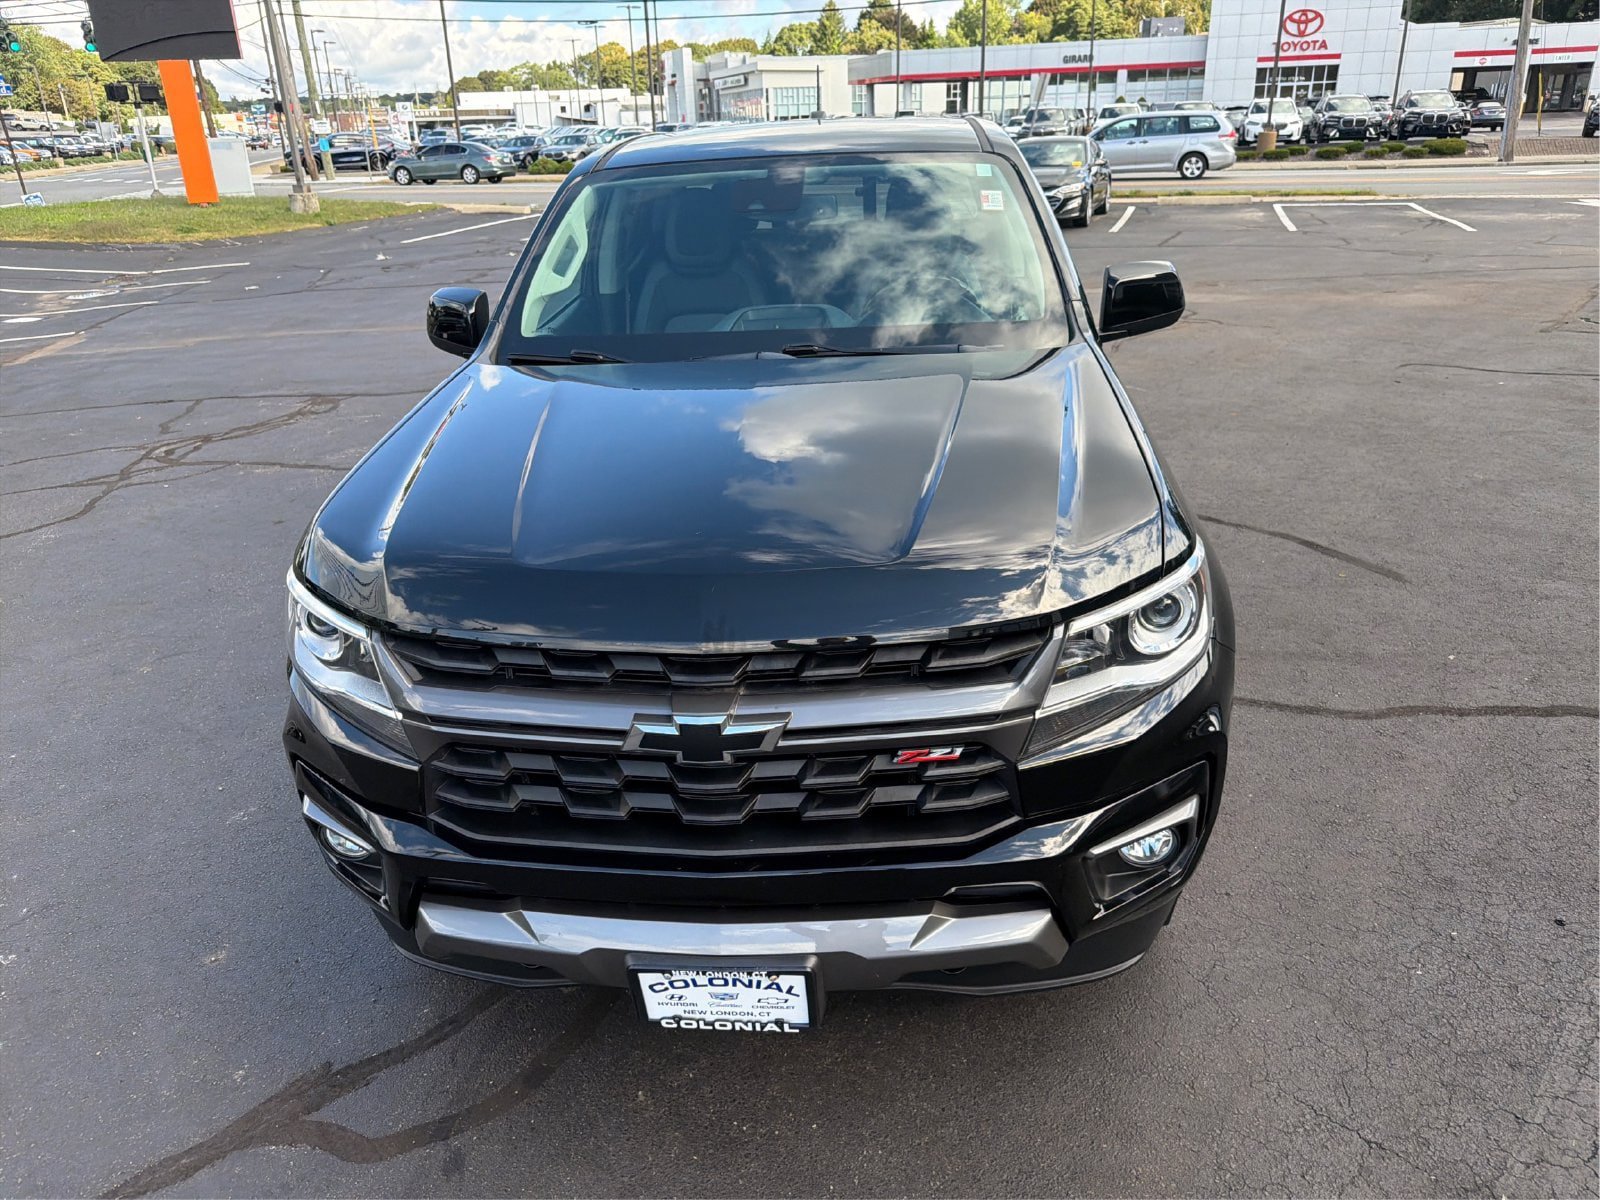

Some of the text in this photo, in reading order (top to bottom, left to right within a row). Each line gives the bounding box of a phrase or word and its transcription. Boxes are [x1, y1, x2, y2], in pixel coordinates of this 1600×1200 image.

[893, 747, 965, 764] Z71
[648, 977, 800, 998] COLONIAL
[710, 1010, 757, 1018] LONDON,
[660, 1018, 800, 1033] COLONIAL
